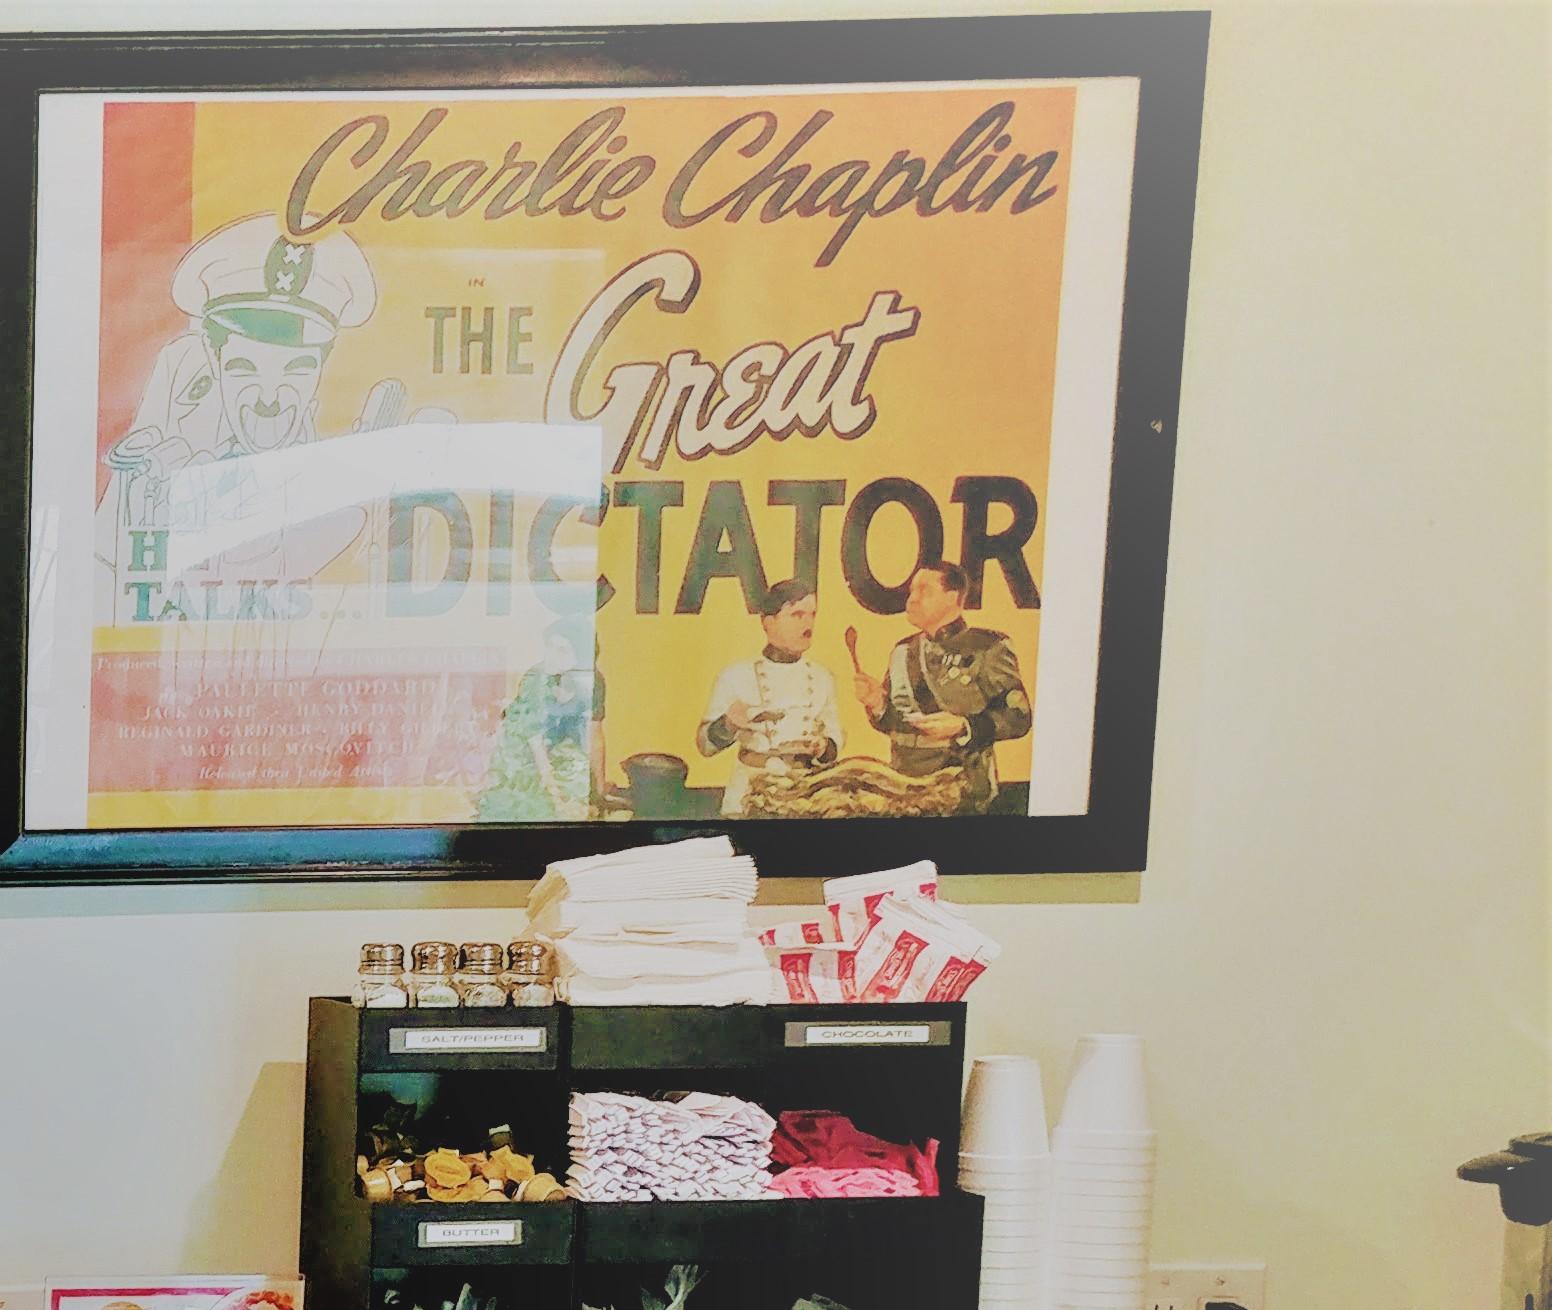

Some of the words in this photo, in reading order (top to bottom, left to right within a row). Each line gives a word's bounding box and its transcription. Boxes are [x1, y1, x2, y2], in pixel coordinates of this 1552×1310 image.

[285, 105, 656, 239] Charlie
[662, 100, 1060, 268] Chaplin
[468, 277, 486, 288] IN
[423, 303, 535, 376] THE
[545, 248, 923, 478] Great
[386, 473, 1043, 617] DICTATOR
[421, 1034, 525, 1044] SALT/PEPPER
[821, 1029, 914, 1039] CHOCOLATE
[442, 1228, 500, 1237] BUTTER
